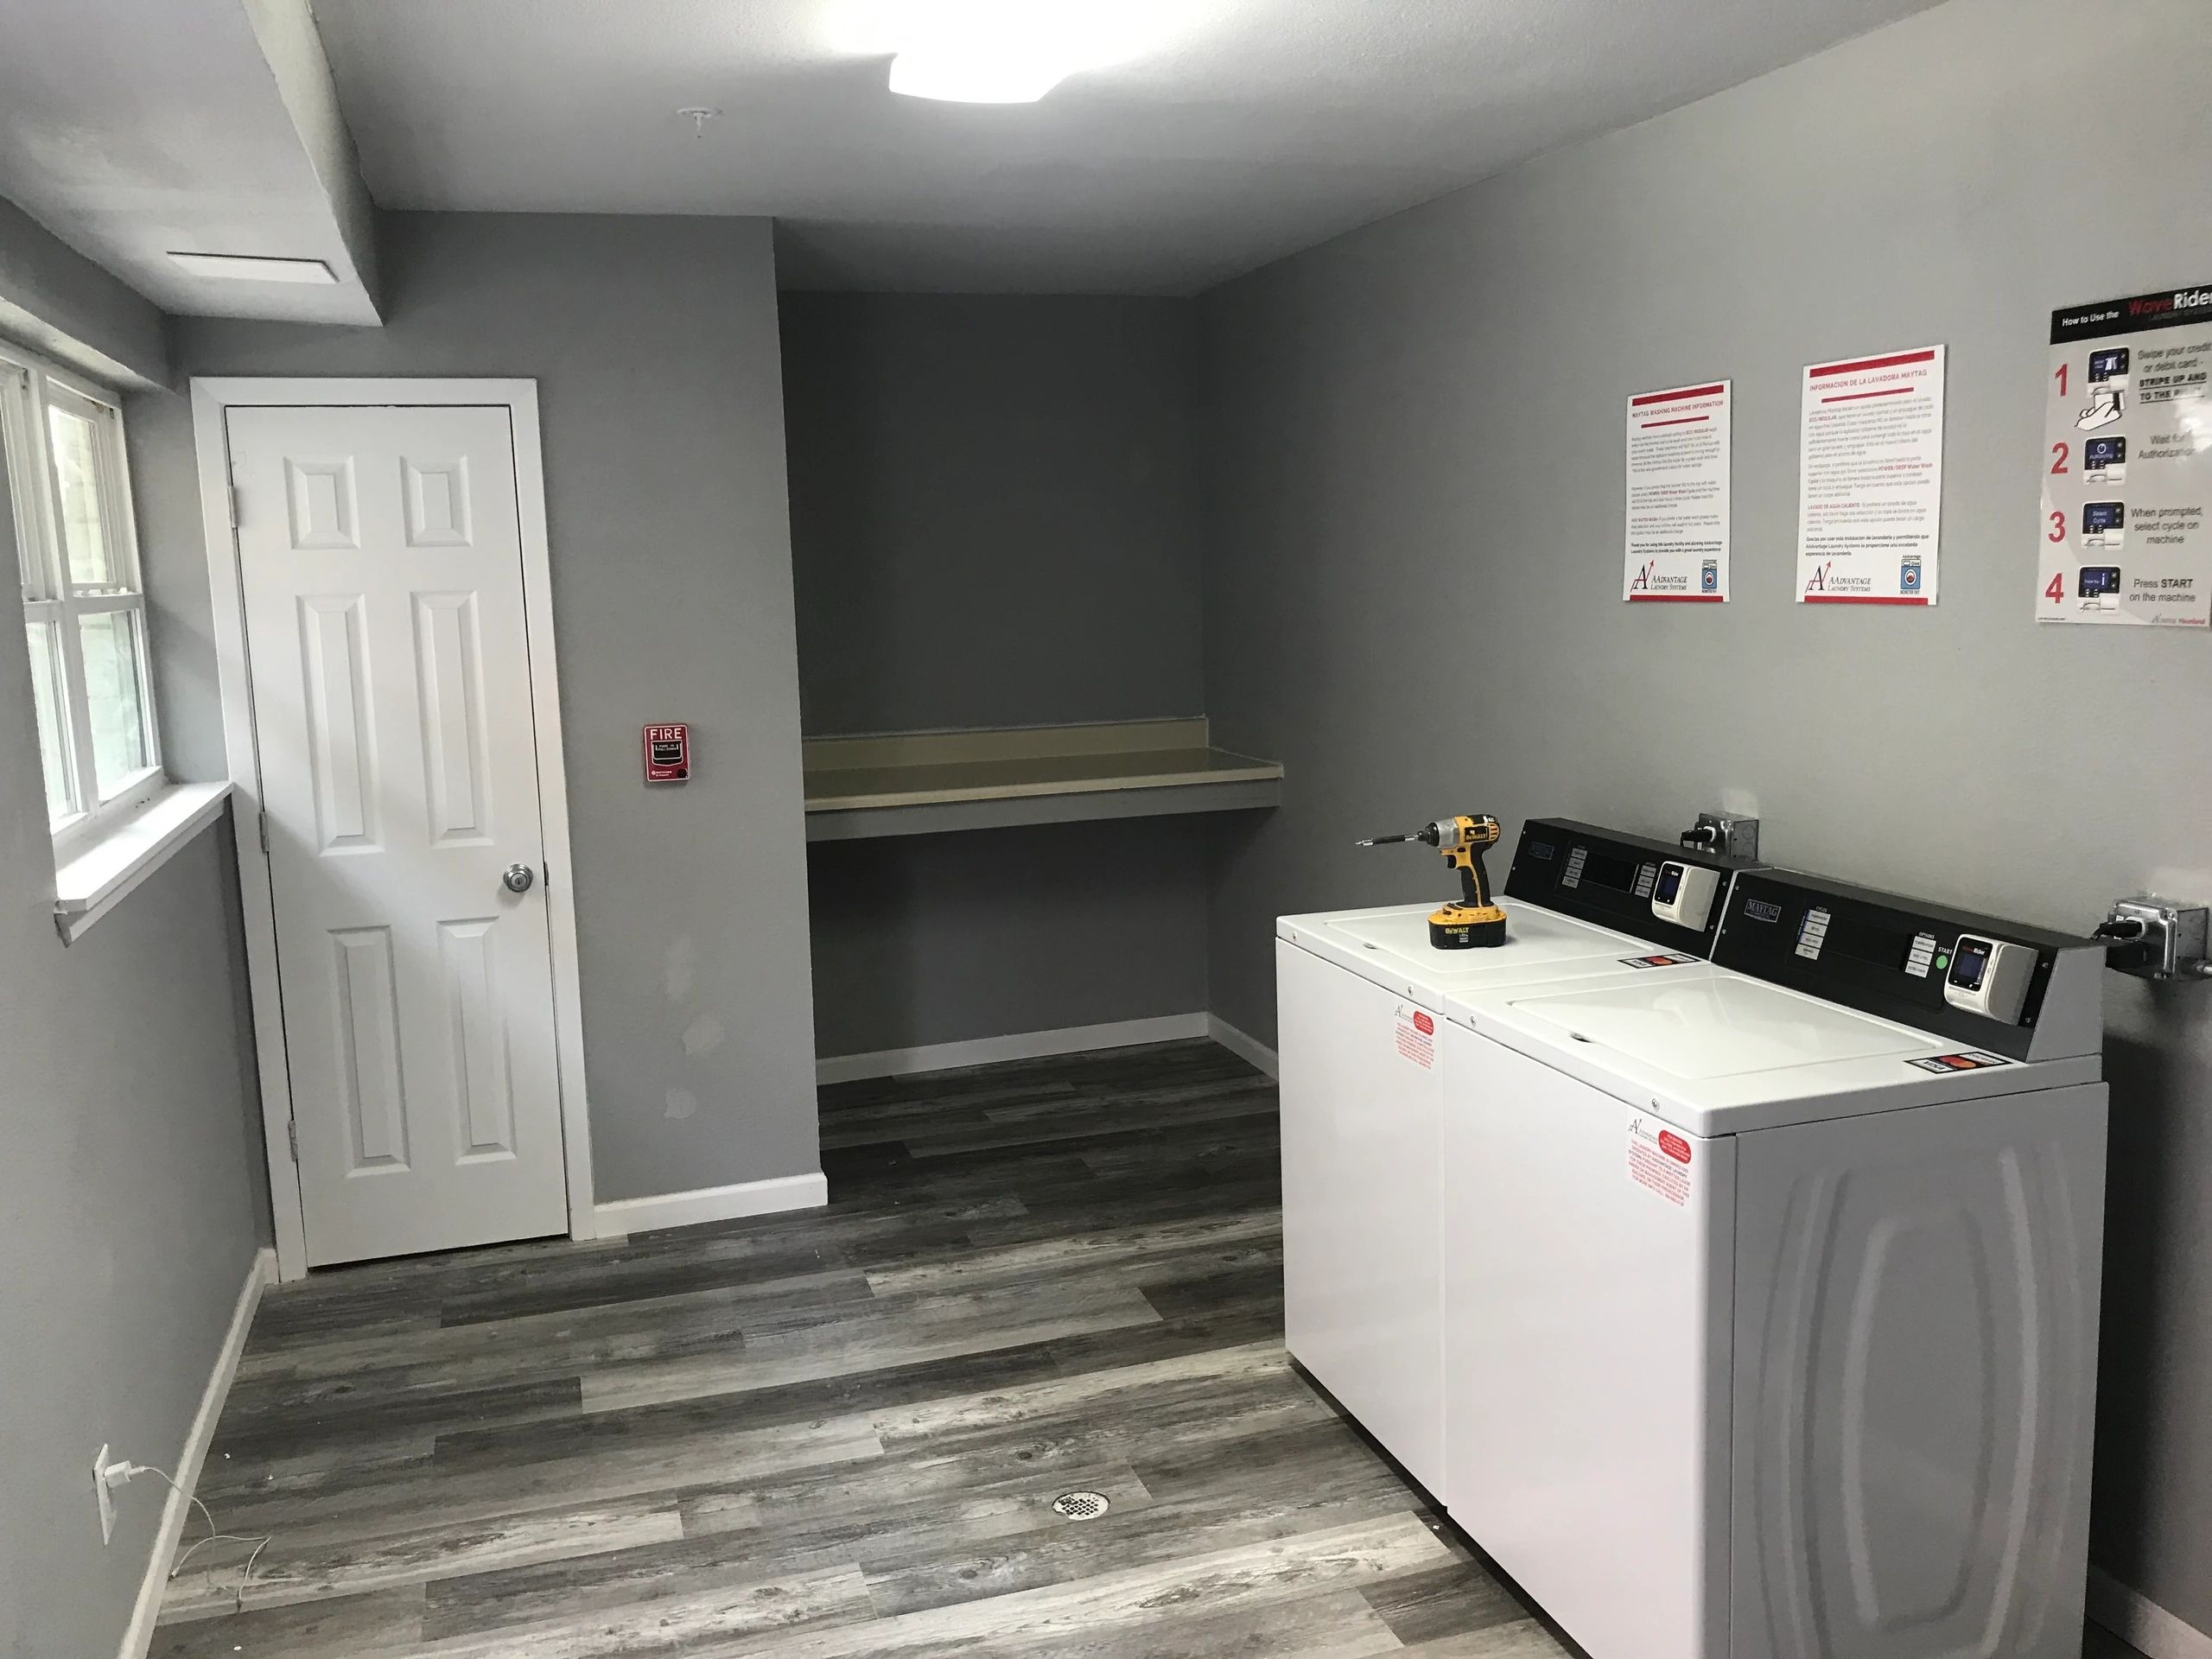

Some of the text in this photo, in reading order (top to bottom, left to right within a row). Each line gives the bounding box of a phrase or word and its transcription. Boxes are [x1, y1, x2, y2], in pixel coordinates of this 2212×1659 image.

[2062, 318, 2079, 327] How
[2090, 314, 2105, 322] Use
[2107, 311, 2120, 320] the
[2138, 349, 2164, 360] Swipe
[2165, 346, 2185, 359] your
[2154, 361, 2176, 372] debit
[2177, 358, 2197, 369] card
[1809, 381, 1848, 391] INFORMACION
[1867, 373, 1900, 384] LAVADORA
[1901, 369, 1927, 378] MAYTAG
[2055, 363, 2068, 397] 1
[2139, 372, 2207, 387] STRIPE UP AND
[2139, 391, 2152, 400] TO
[2154, 390, 2171, 399] THE
[1632, 410, 1649, 418] MAYTAG
[1692, 400, 1724, 410] INFORMATION
[2150, 435, 2171, 444] Wait
[2051, 442, 2069, 474] 2
[2131, 508, 2156, 518] When
[2048, 511, 2066, 543] 3
[2134, 520, 2199, 532] select cycle on
[2146, 535, 2184, 544] machine
[2045, 572, 2064, 604] 4
[2133, 578, 2193, 588] Press START
[2142, 592, 2156, 601] the
[2158, 593, 2196, 602] machine
[650, 728, 683, 741] FIRE
[1746, 901, 1778, 917] MAYTAG
